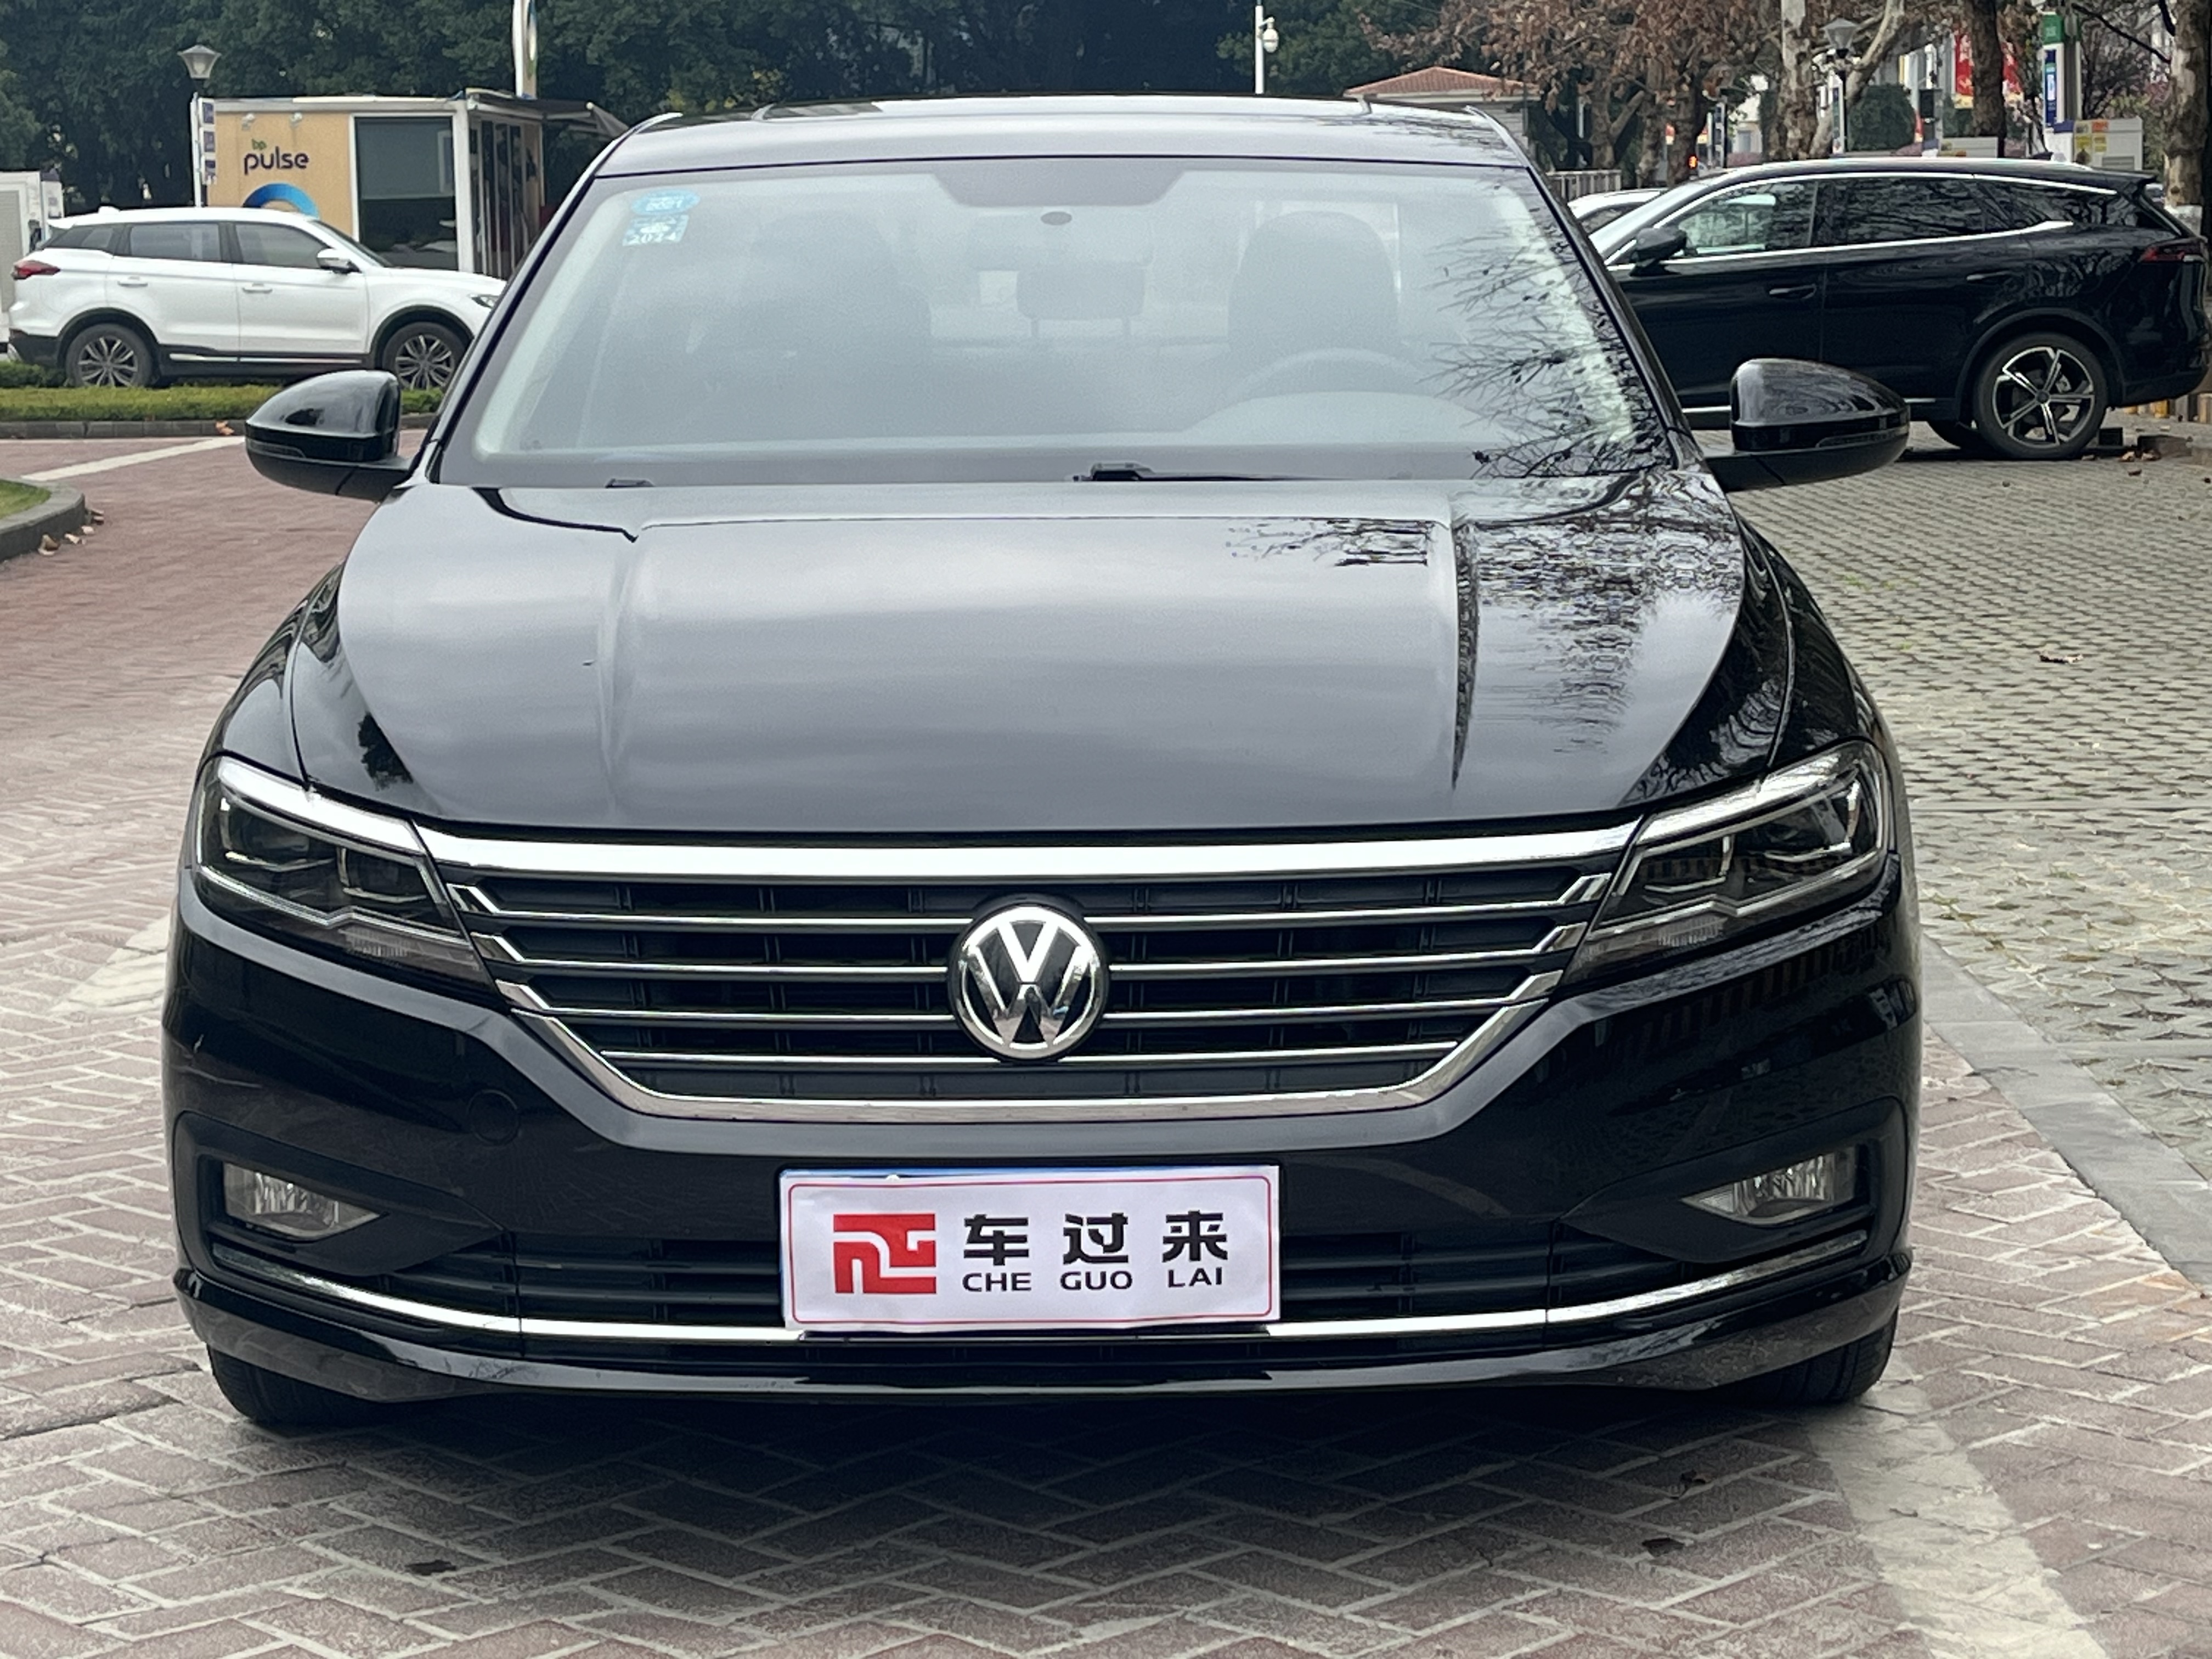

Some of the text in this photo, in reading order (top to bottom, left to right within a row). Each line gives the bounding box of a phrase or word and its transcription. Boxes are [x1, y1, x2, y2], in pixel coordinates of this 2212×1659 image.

[252, 138, 267, 151] bp
[244, 146, 309, 176] pulse
[964, 1211, 1227, 1266] 车过来
[962, 1267, 1223, 1292] CHE GUO LAI
